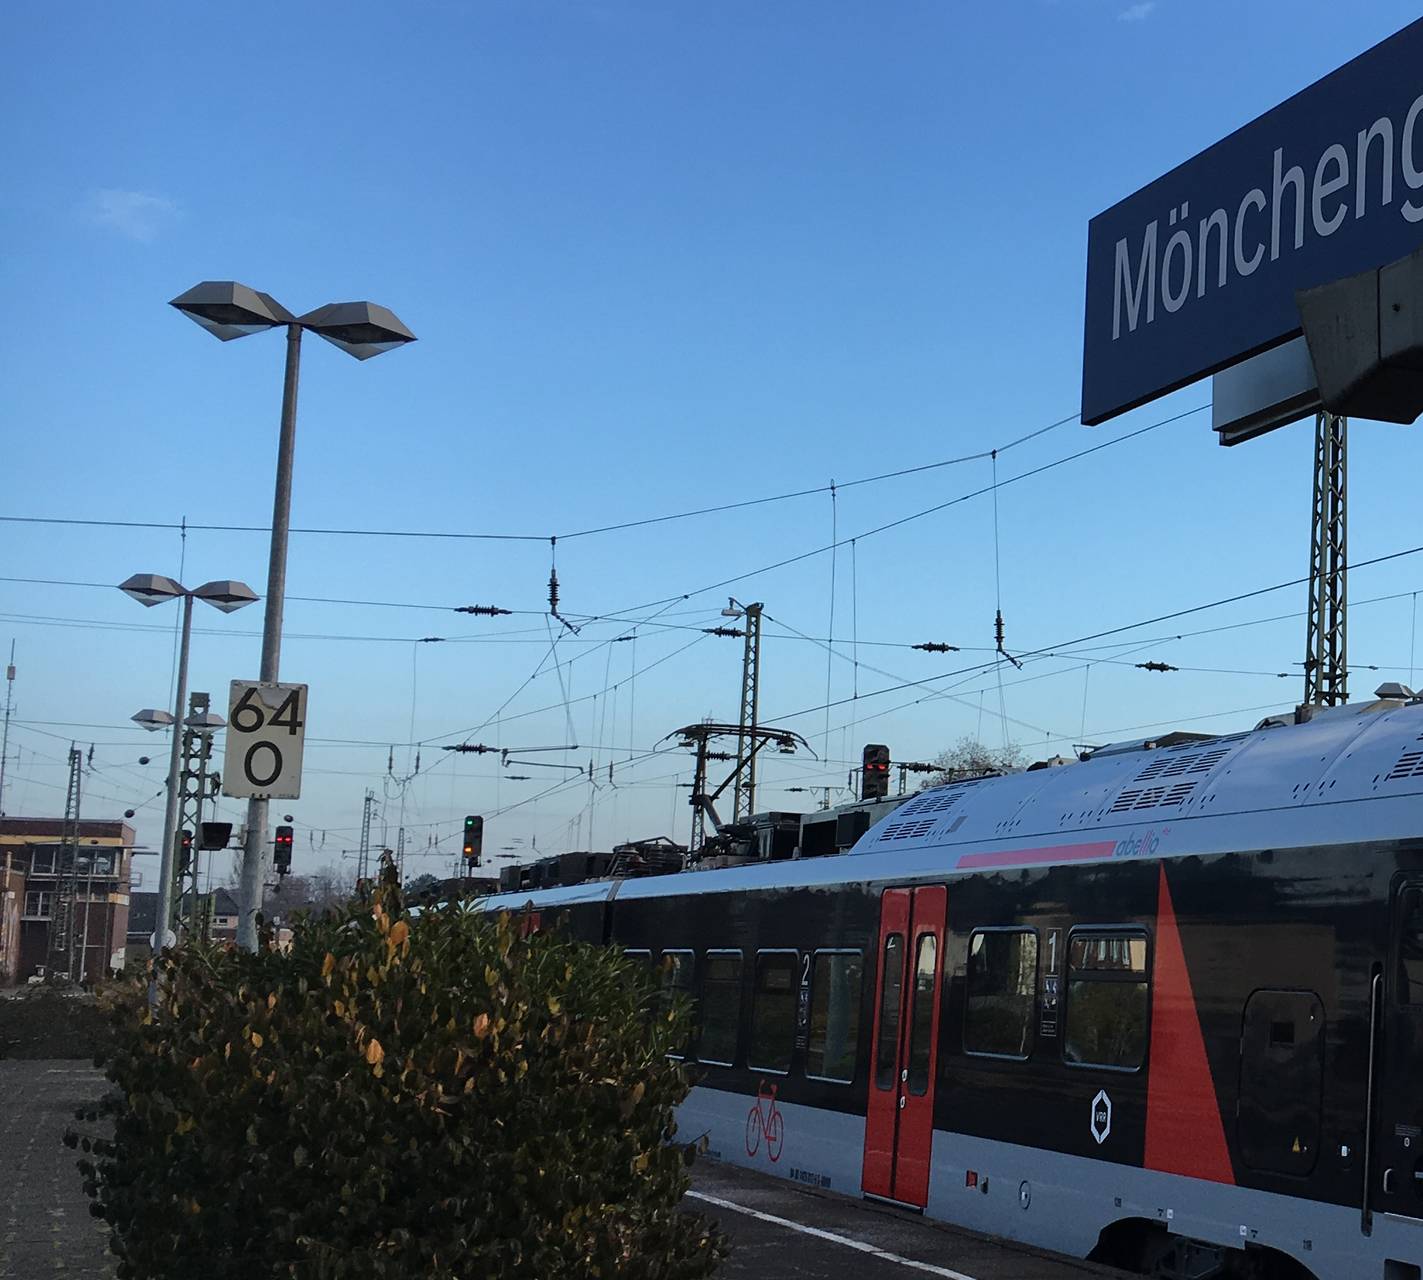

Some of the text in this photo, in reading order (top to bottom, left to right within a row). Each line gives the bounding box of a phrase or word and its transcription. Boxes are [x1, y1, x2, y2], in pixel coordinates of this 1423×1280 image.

[230, 687, 303, 736] 64
[244, 740, 283, 787] 0
[1116, 830, 1160, 856] abellio
[801, 953, 811, 986] 2
[1048, 930, 1057, 973] 1
